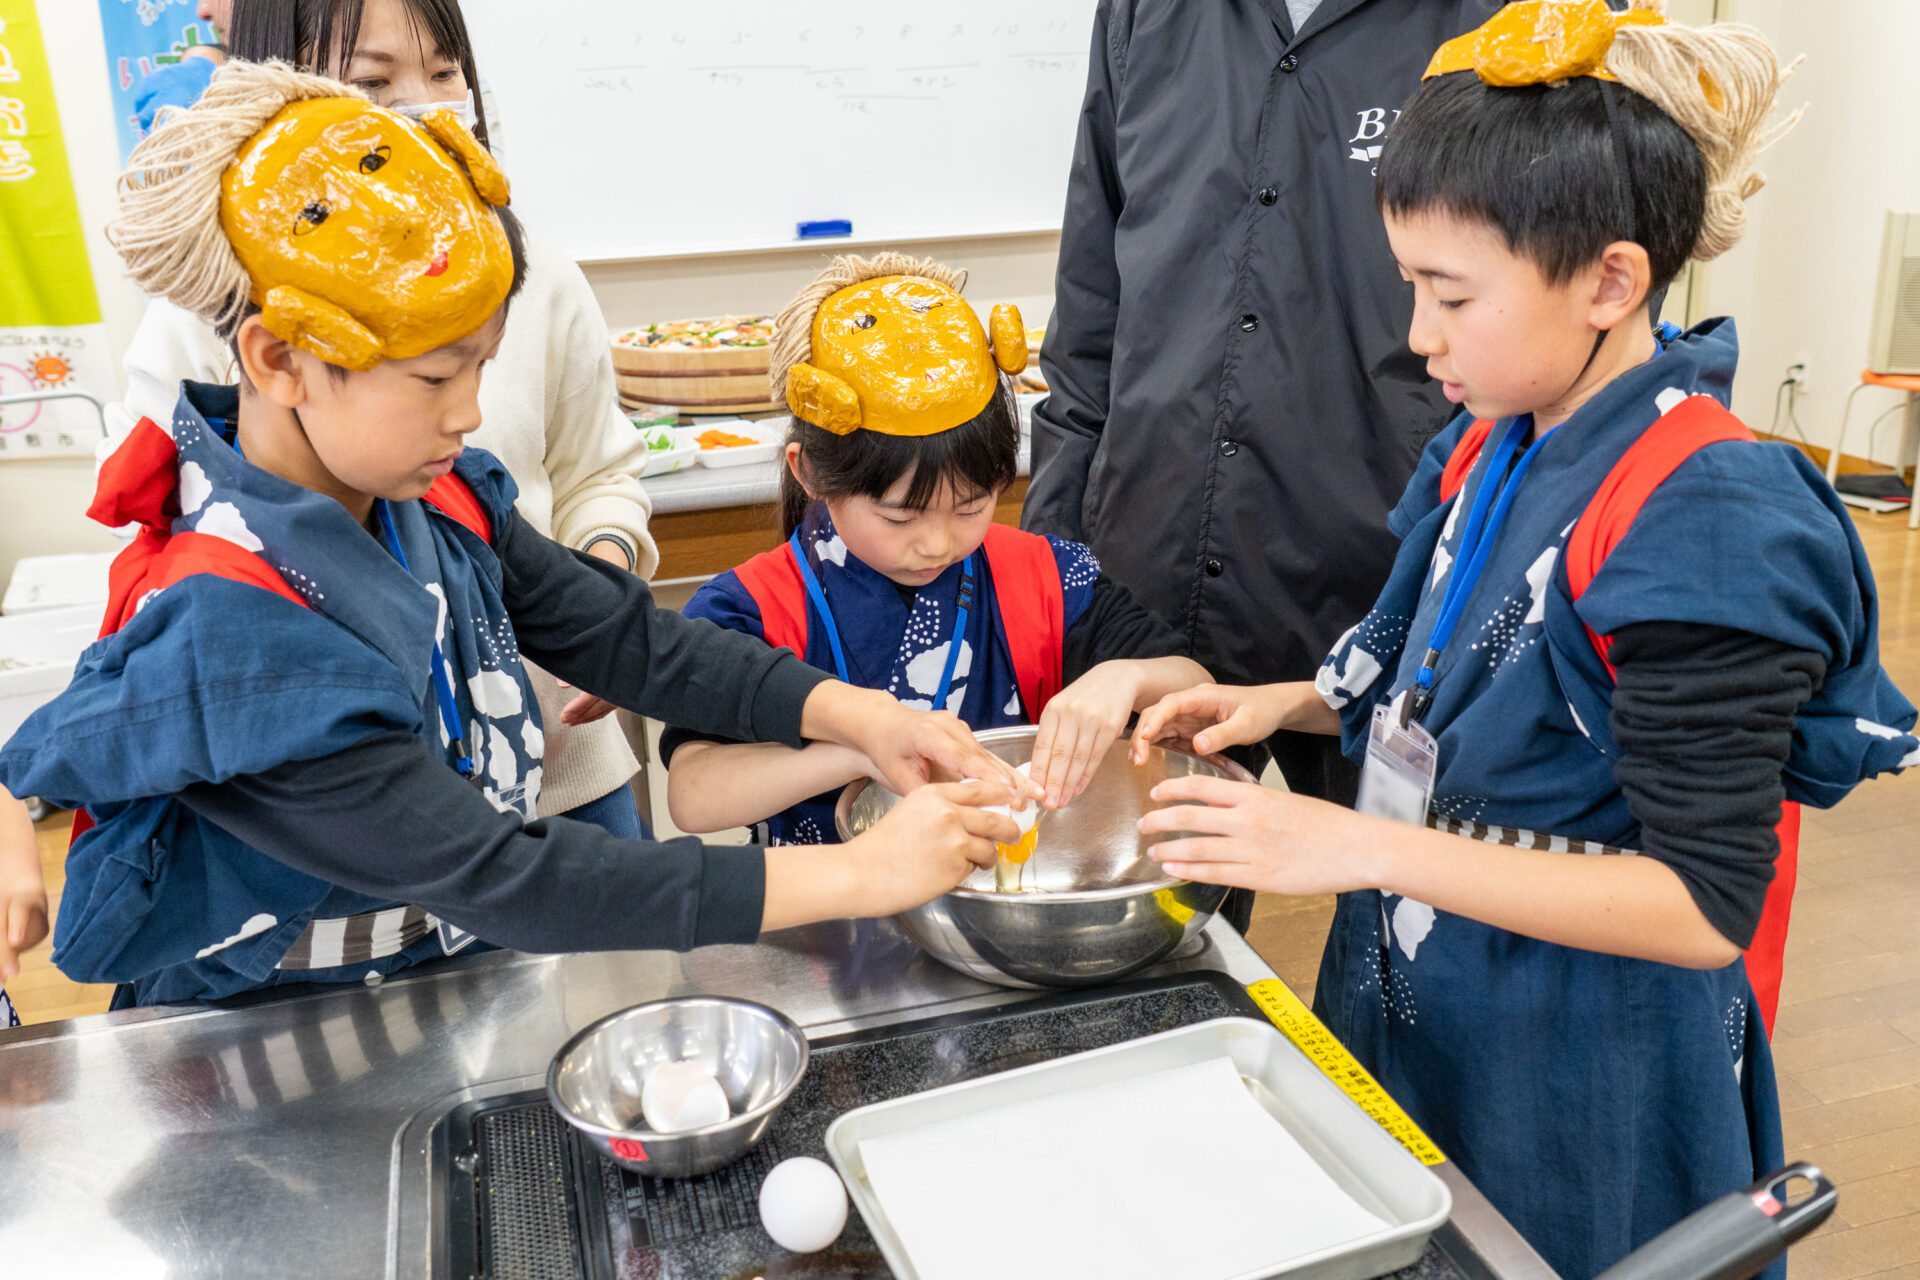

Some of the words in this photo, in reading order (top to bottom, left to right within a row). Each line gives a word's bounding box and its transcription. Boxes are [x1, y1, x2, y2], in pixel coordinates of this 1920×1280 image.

[580, 35, 591, 48] 2
[798, 29, 811, 43] 6
[852, 26, 864, 42] 7
[899, 24, 912, 39] 8
